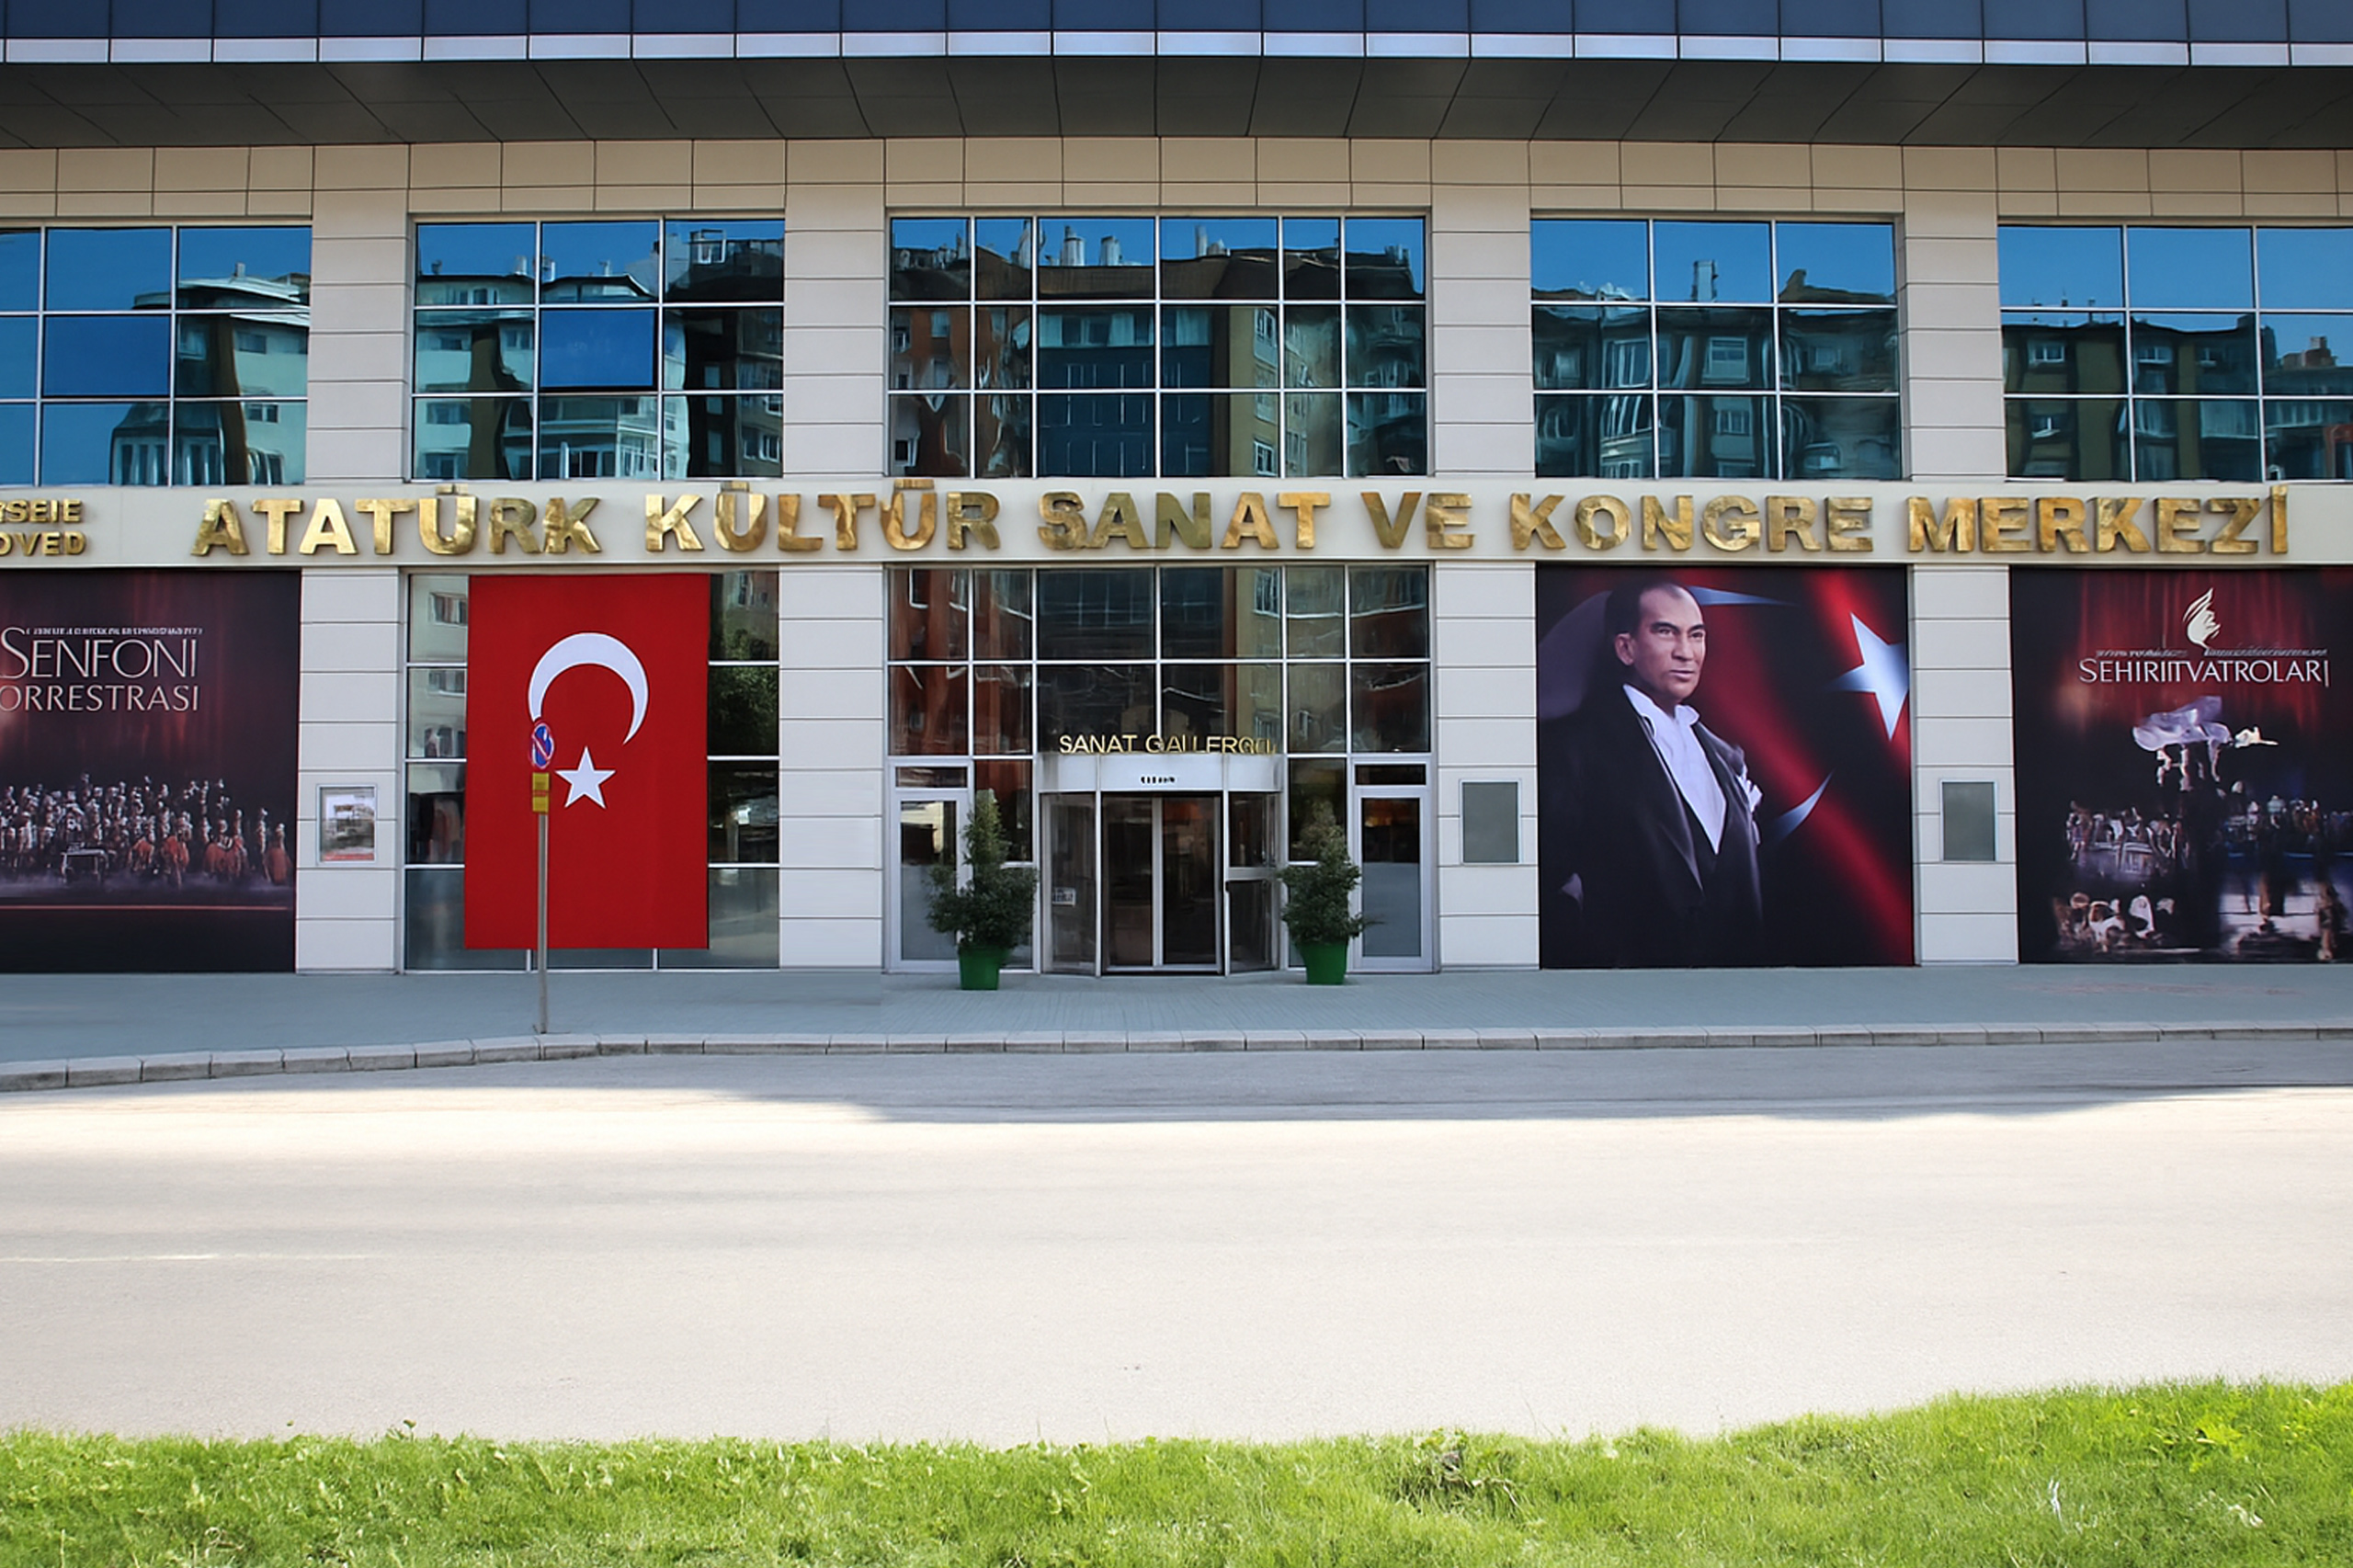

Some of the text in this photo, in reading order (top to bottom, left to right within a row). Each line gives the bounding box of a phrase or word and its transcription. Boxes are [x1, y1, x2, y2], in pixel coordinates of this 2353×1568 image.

[189, 478, 2290, 556] ATATÜRK KÜLTÜR SANAT VE KONGRE MERKEZİ
[1059, 733, 1138, 754] SANAT
